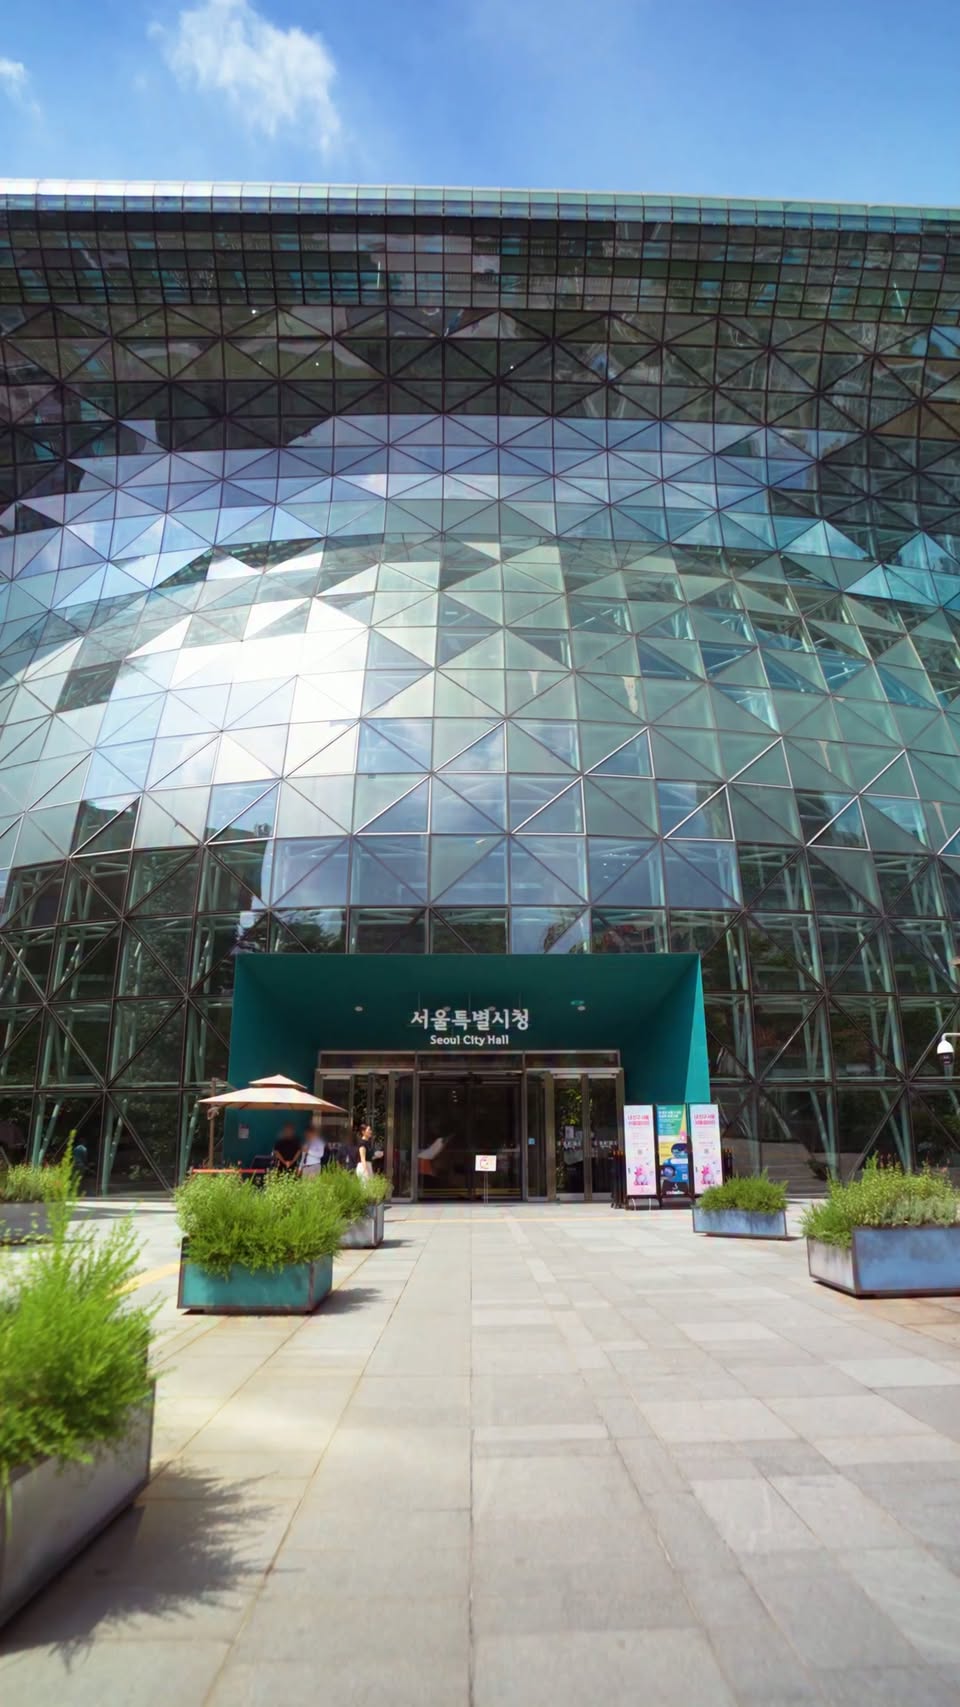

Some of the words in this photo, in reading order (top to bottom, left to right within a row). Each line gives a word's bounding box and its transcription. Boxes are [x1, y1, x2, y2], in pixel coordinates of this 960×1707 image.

[410, 1008, 529, 1031] 서울특별시청
[430, 1035, 460, 1045] Seoul
[463, 1035, 485, 1047] City
[487, 1035, 509, 1045] Hall
